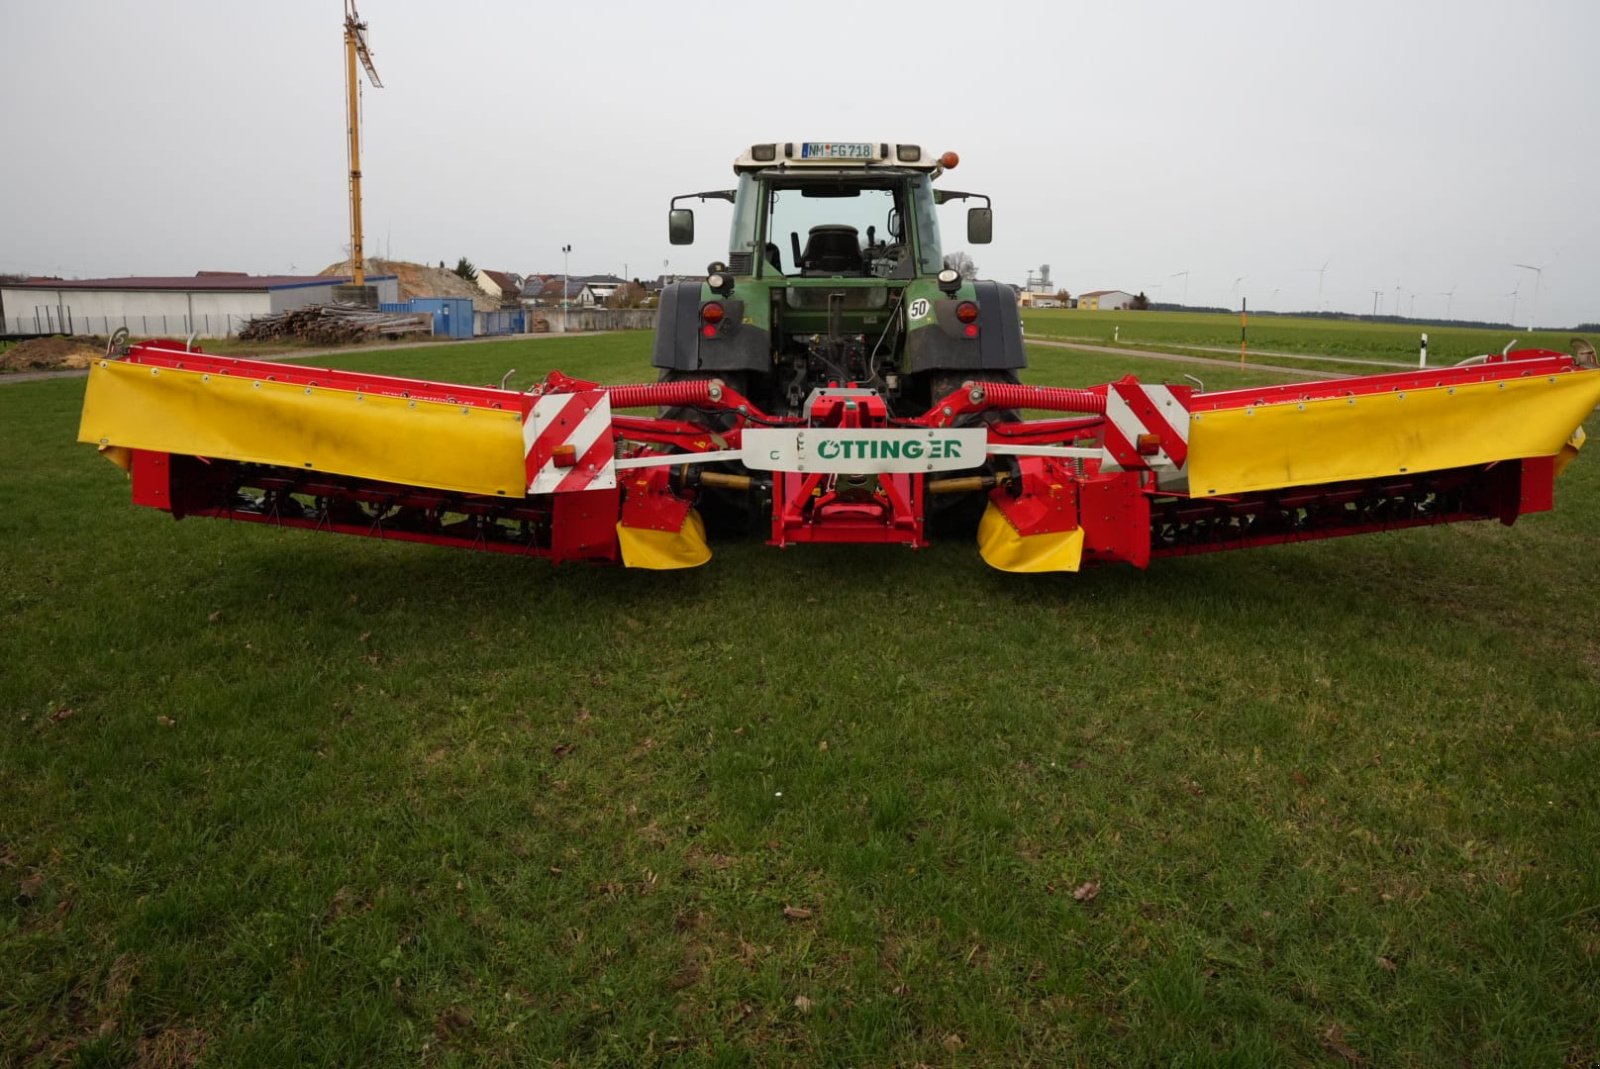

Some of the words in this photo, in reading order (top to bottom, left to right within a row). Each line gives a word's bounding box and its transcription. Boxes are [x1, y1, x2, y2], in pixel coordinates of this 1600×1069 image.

[809, 143, 824, 156] NM
[830, 144, 846, 157] FG
[848, 144, 871, 157] 718
[911, 300, 927, 317] 50
